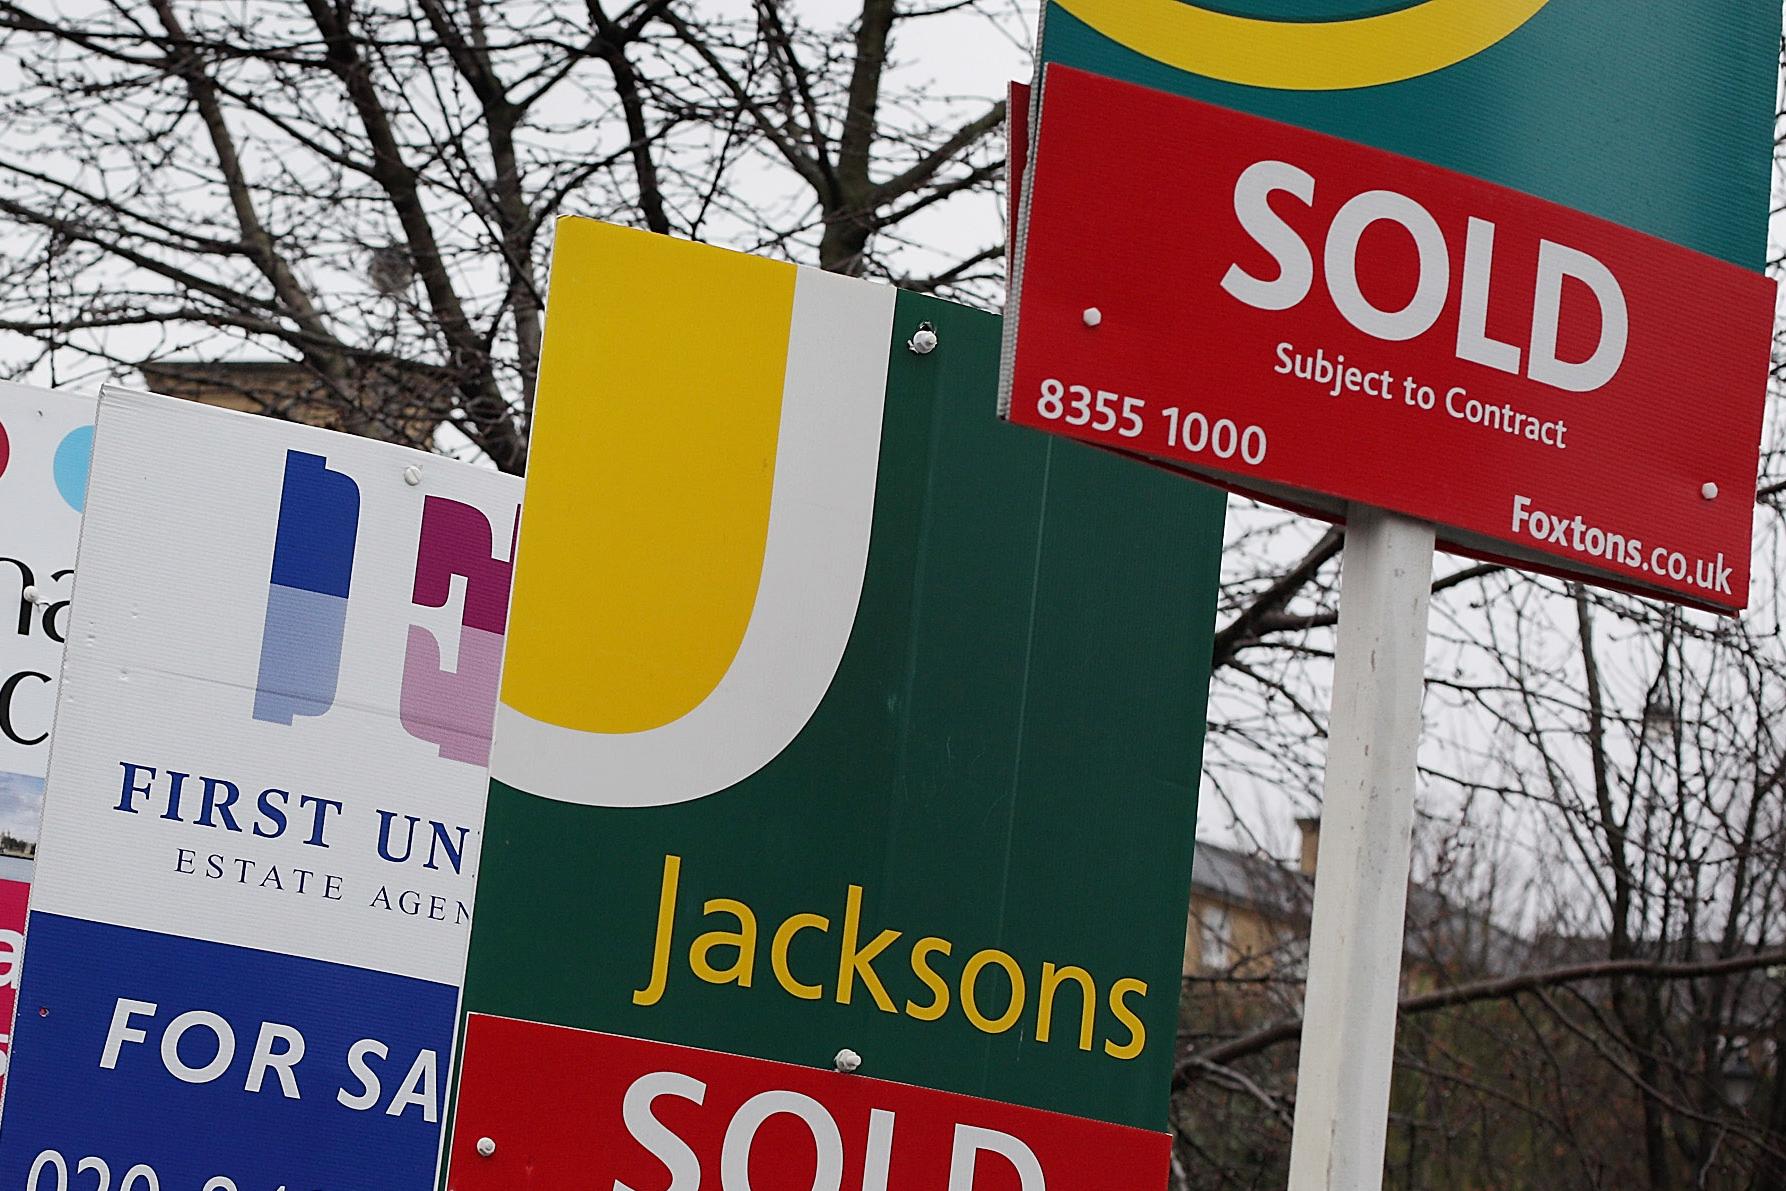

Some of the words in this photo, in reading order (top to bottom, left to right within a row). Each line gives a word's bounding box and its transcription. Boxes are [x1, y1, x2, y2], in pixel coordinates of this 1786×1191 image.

[1220, 160, 1629, 393] SOLD
[1036, 379, 1146, 438] 8355
[1161, 407, 1268, 465] 1000
[1274, 342, 1394, 397] Subject
[1403, 376, 1435, 409] to
[1445, 387, 1568, 449] Contract
[1511, 494, 1734, 596] Foxtons.co.uk
[113, 762, 342, 848] FIRST
[376, 809, 479, 878] UN
[174, 849, 343, 900] ESTATE
[633, 855, 1148, 1060] Jacksons
[100, 998, 305, 1100] FOR
[337, 1038, 438, 1123] SA
